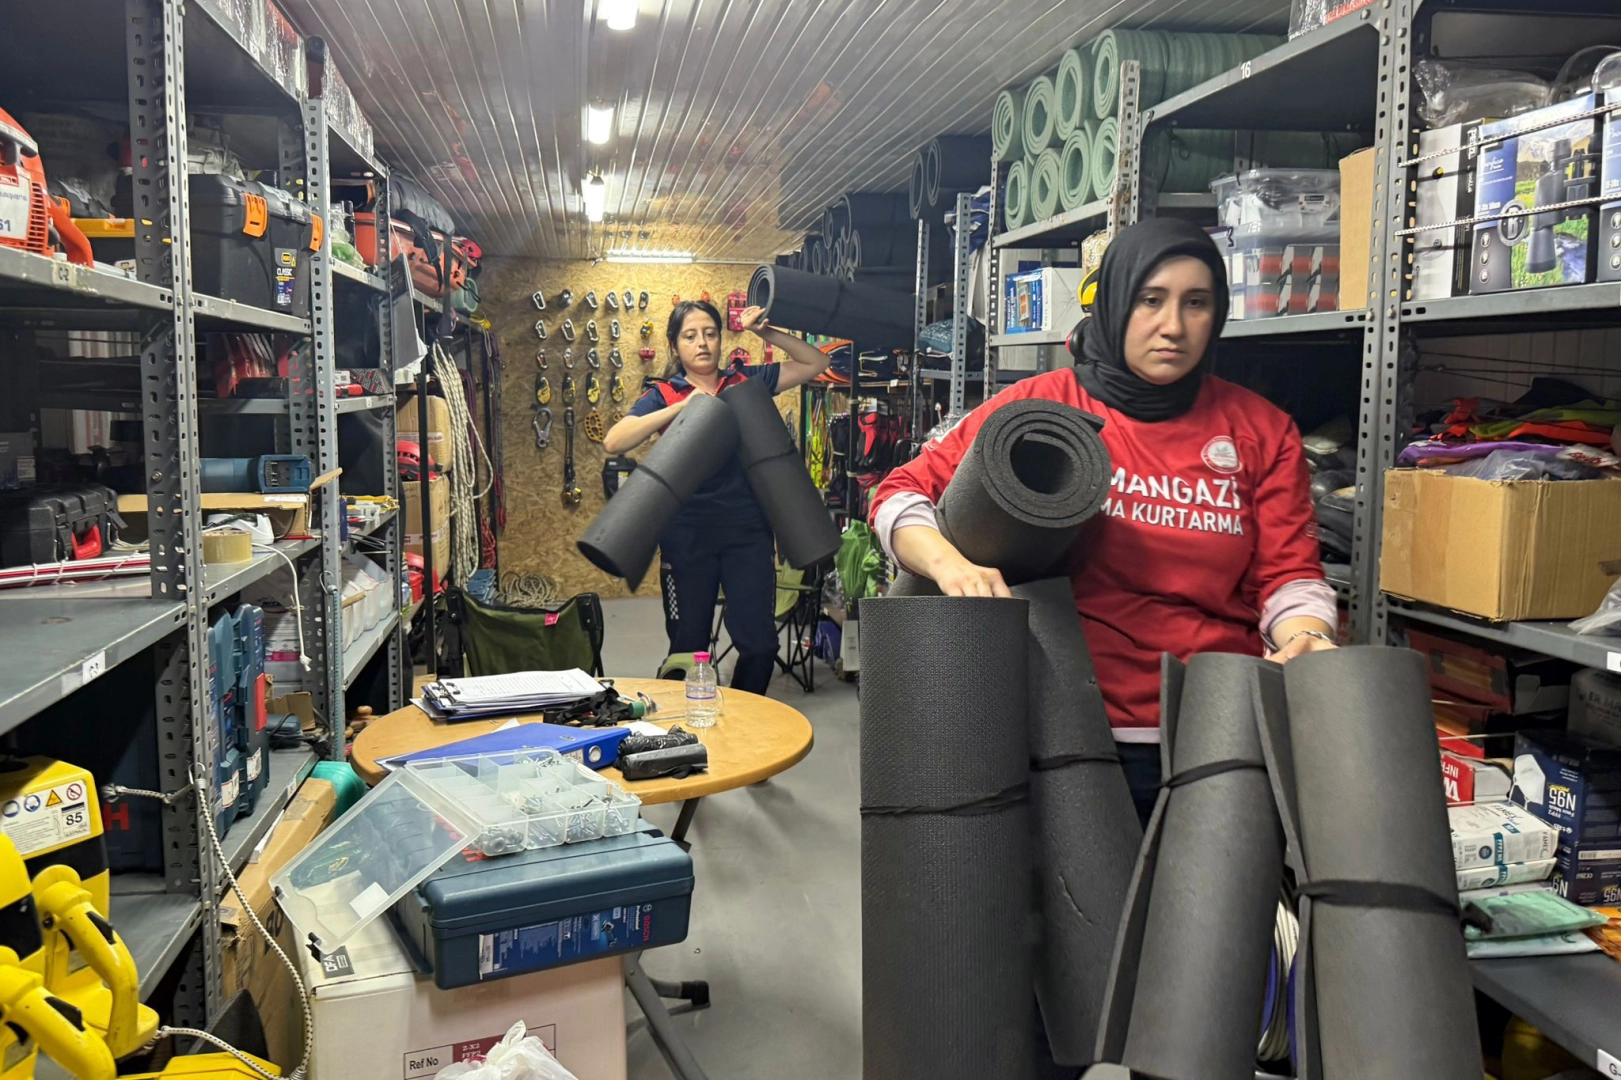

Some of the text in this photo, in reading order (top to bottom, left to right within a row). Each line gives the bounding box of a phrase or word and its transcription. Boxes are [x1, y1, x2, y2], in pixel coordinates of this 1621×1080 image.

[1240, 60, 1251, 79] 16
[1132, 501, 1244, 536] KURTARMA
[1548, 786, 1577, 812] N95
[65, 811, 83, 826] 85
[1552, 876, 1569, 898] N9
[643, 915, 651, 941] BOSCH
[408, 1056, 439, 1071] Ref No
